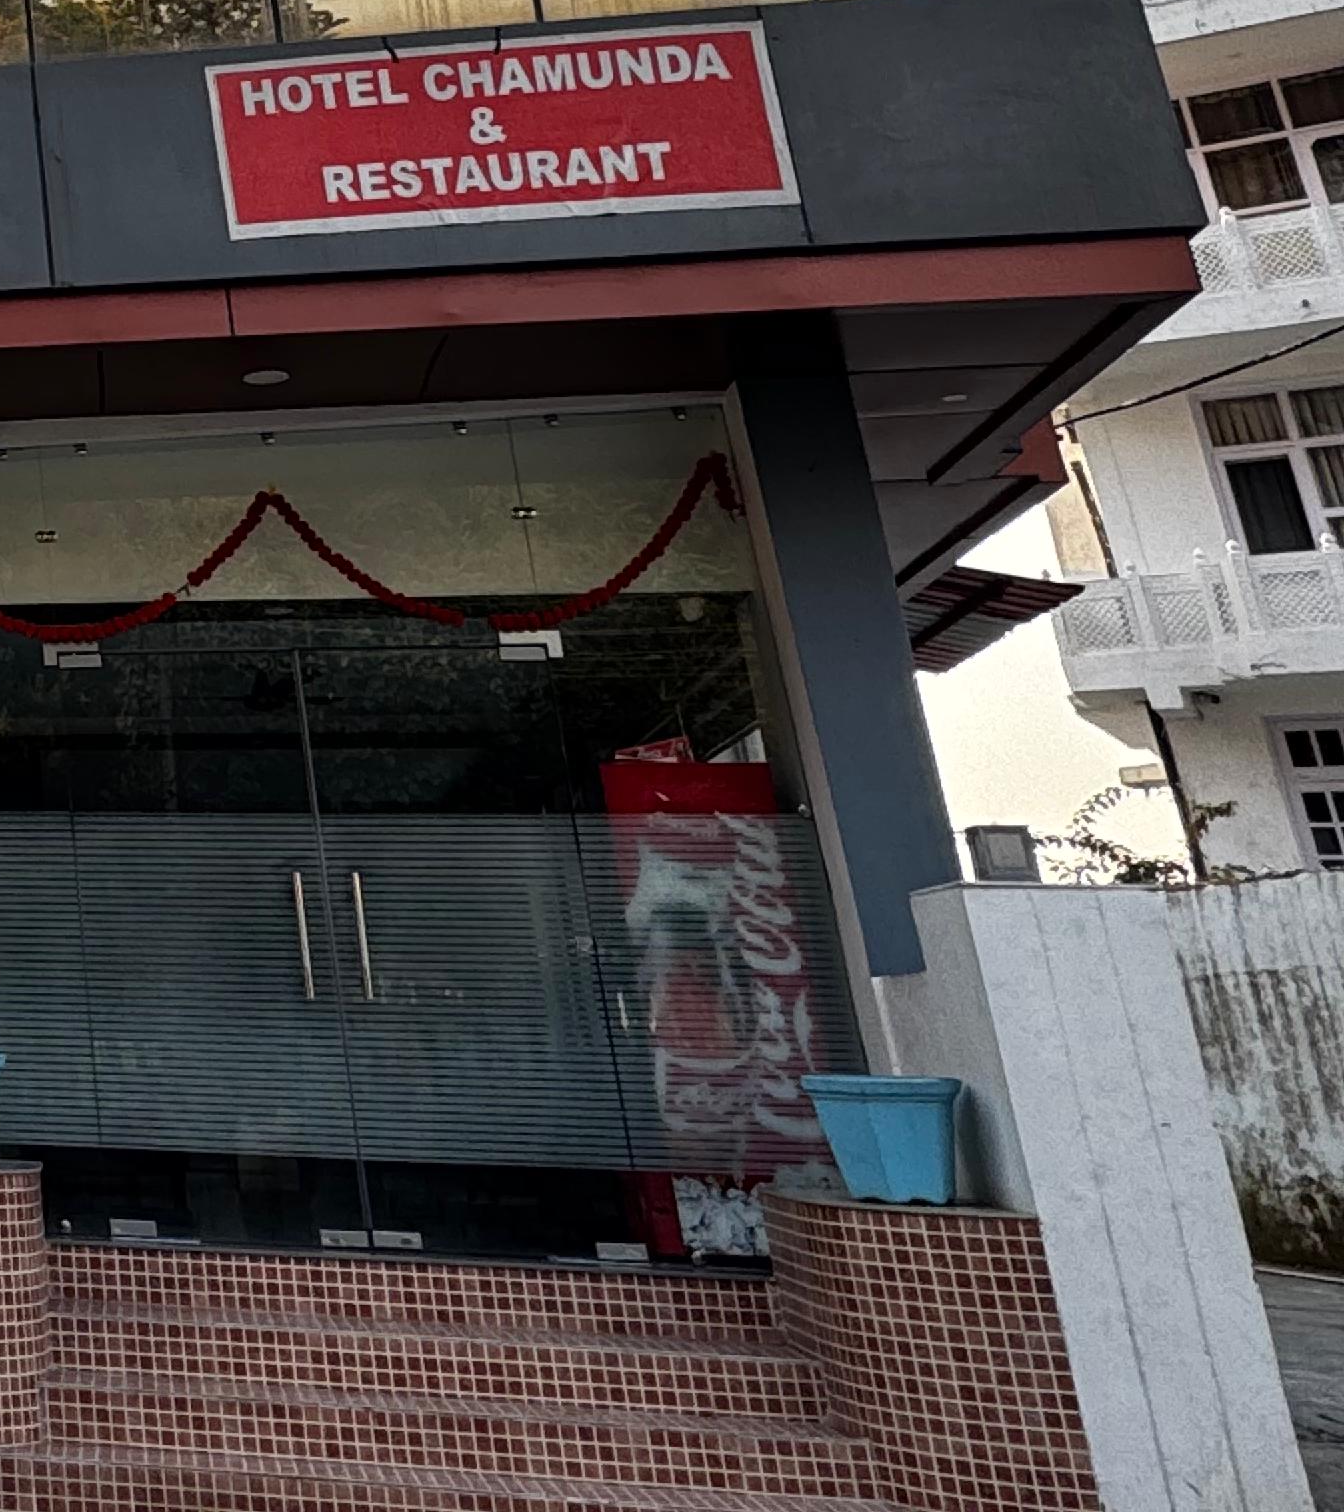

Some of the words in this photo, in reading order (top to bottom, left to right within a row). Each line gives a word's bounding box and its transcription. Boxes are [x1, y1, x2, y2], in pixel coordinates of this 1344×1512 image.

[240, 68, 410, 117] HOTEL
[422, 42, 733, 102] CHAMUNDA
[469, 106, 508, 146] &
[322, 141, 672, 203] RESTAURANT
